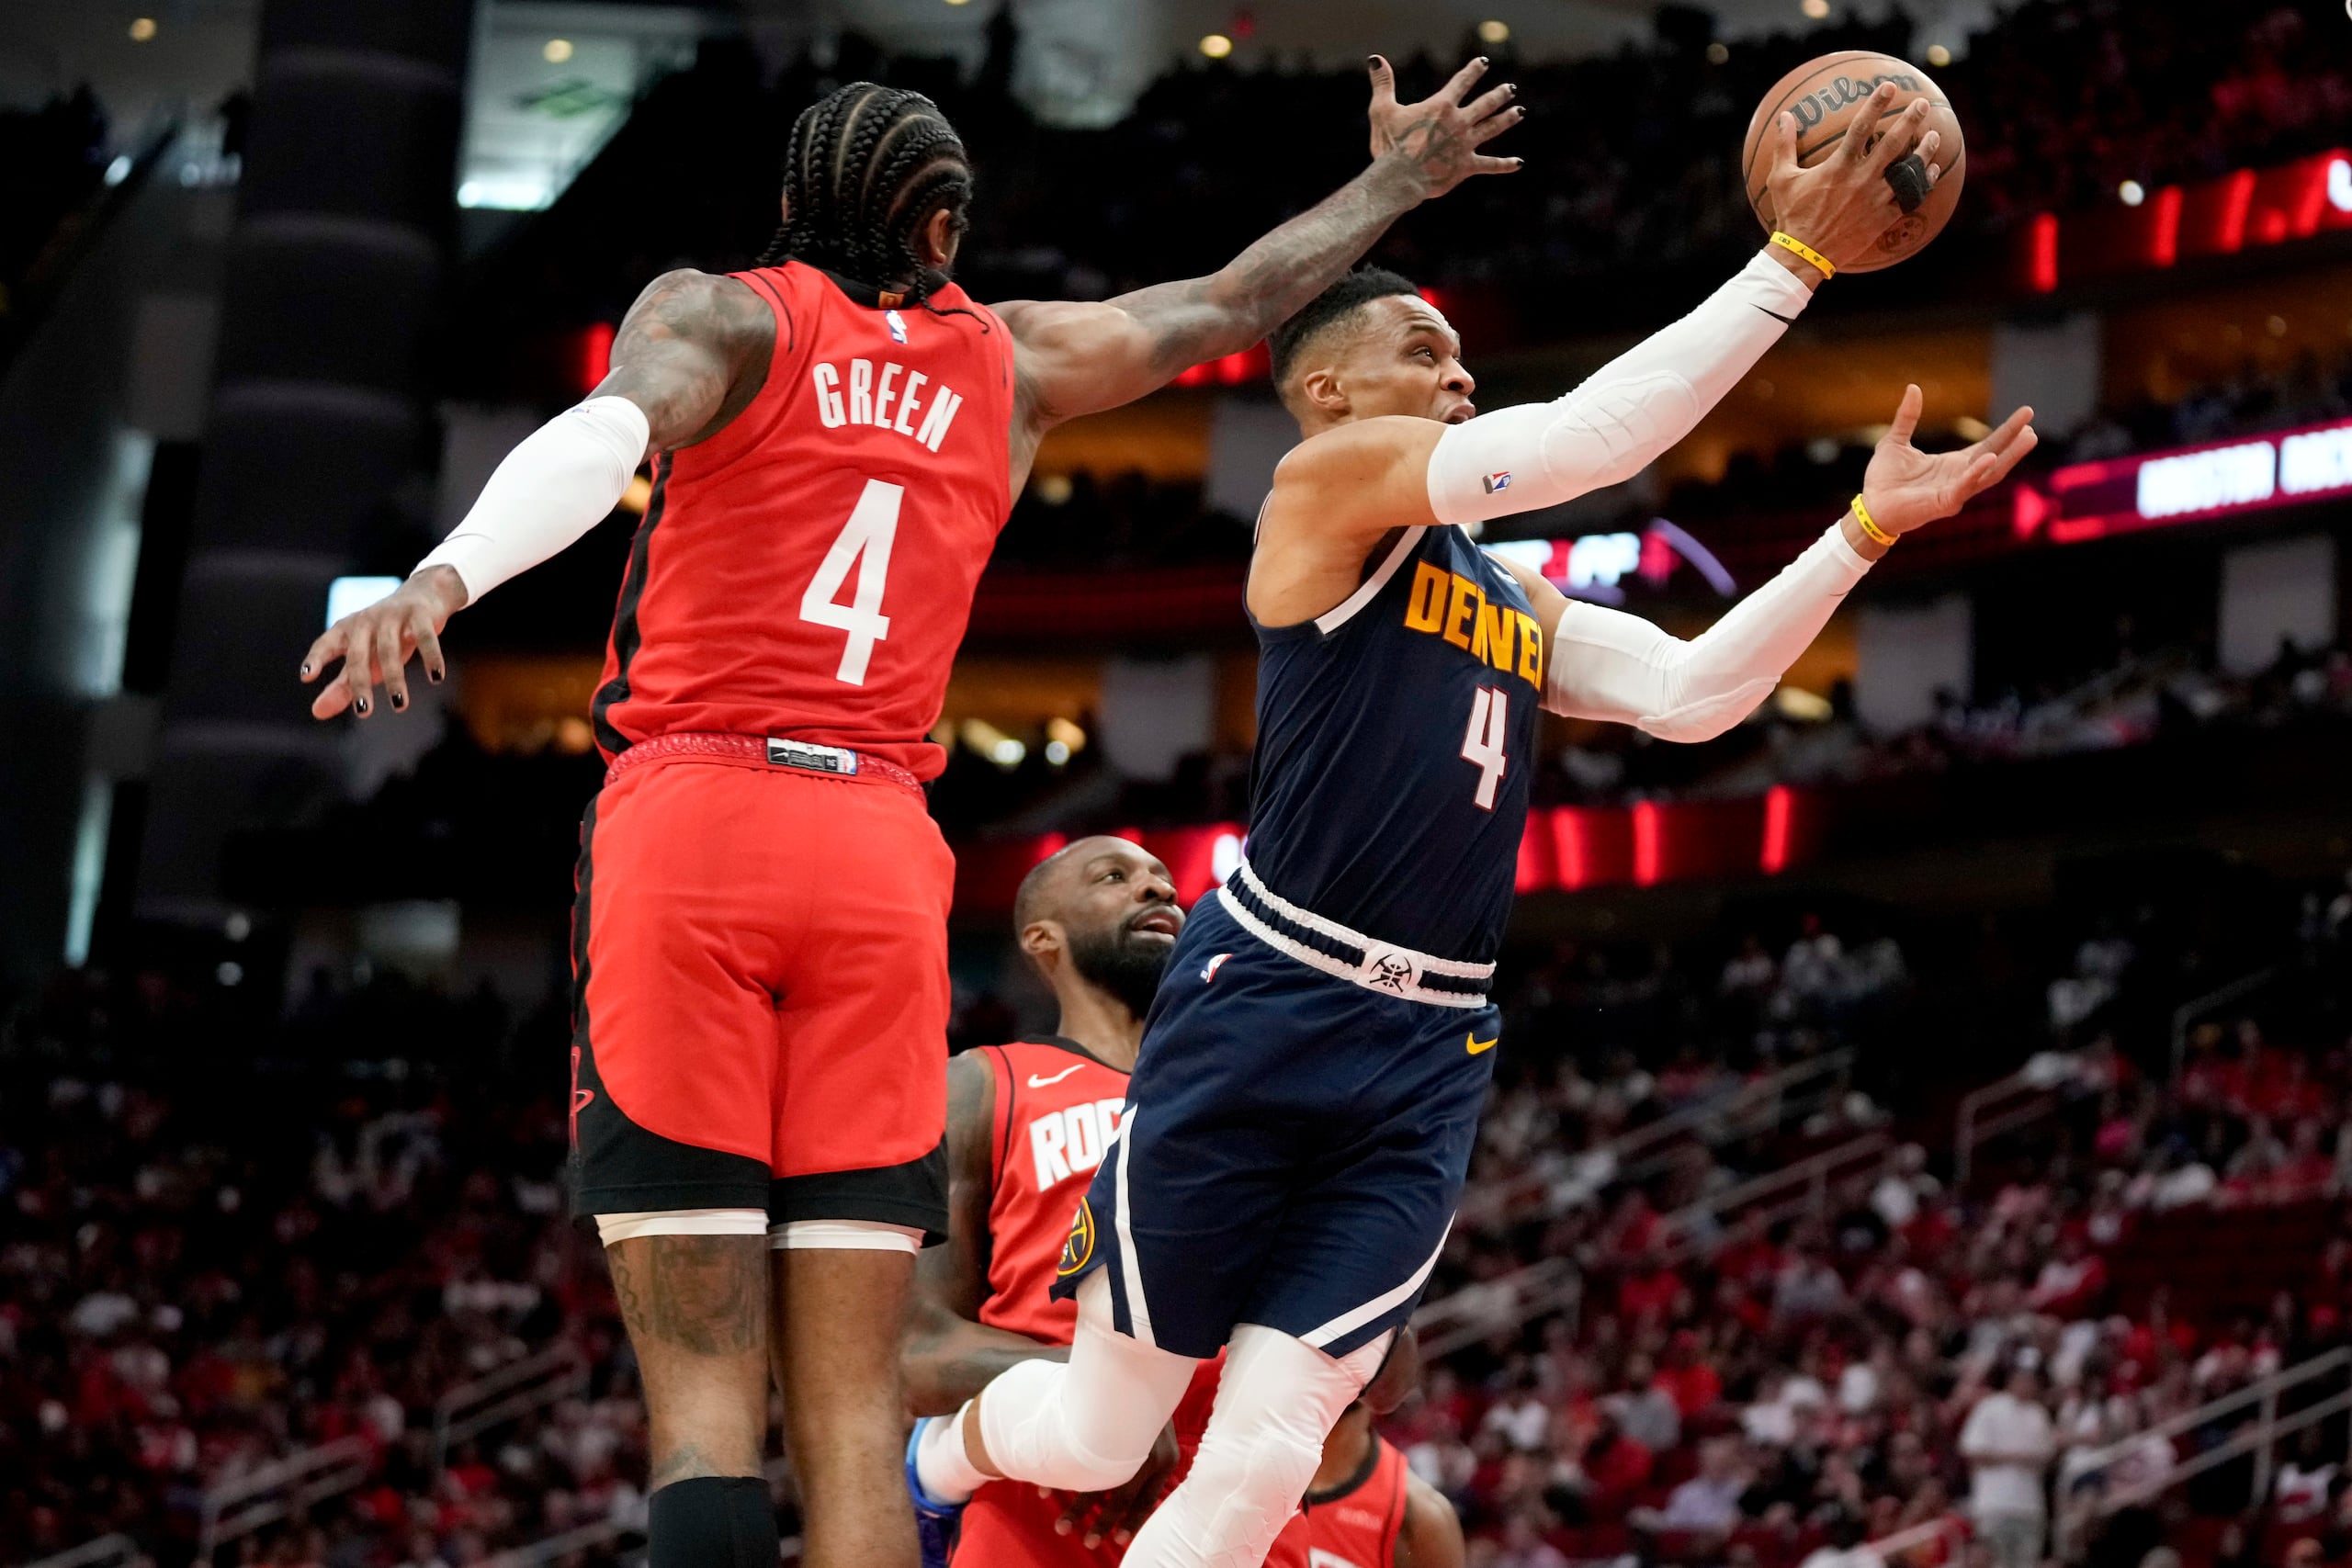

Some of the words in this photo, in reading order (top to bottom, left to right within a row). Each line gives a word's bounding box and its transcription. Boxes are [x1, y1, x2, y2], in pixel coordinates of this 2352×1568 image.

[1777, 75, 1921, 137] Wilson
[813, 358, 964, 453] GREEN
[798, 478, 905, 686] 4
[1403, 558, 1544, 693] DENVE
[1459, 684, 1510, 812] 4
